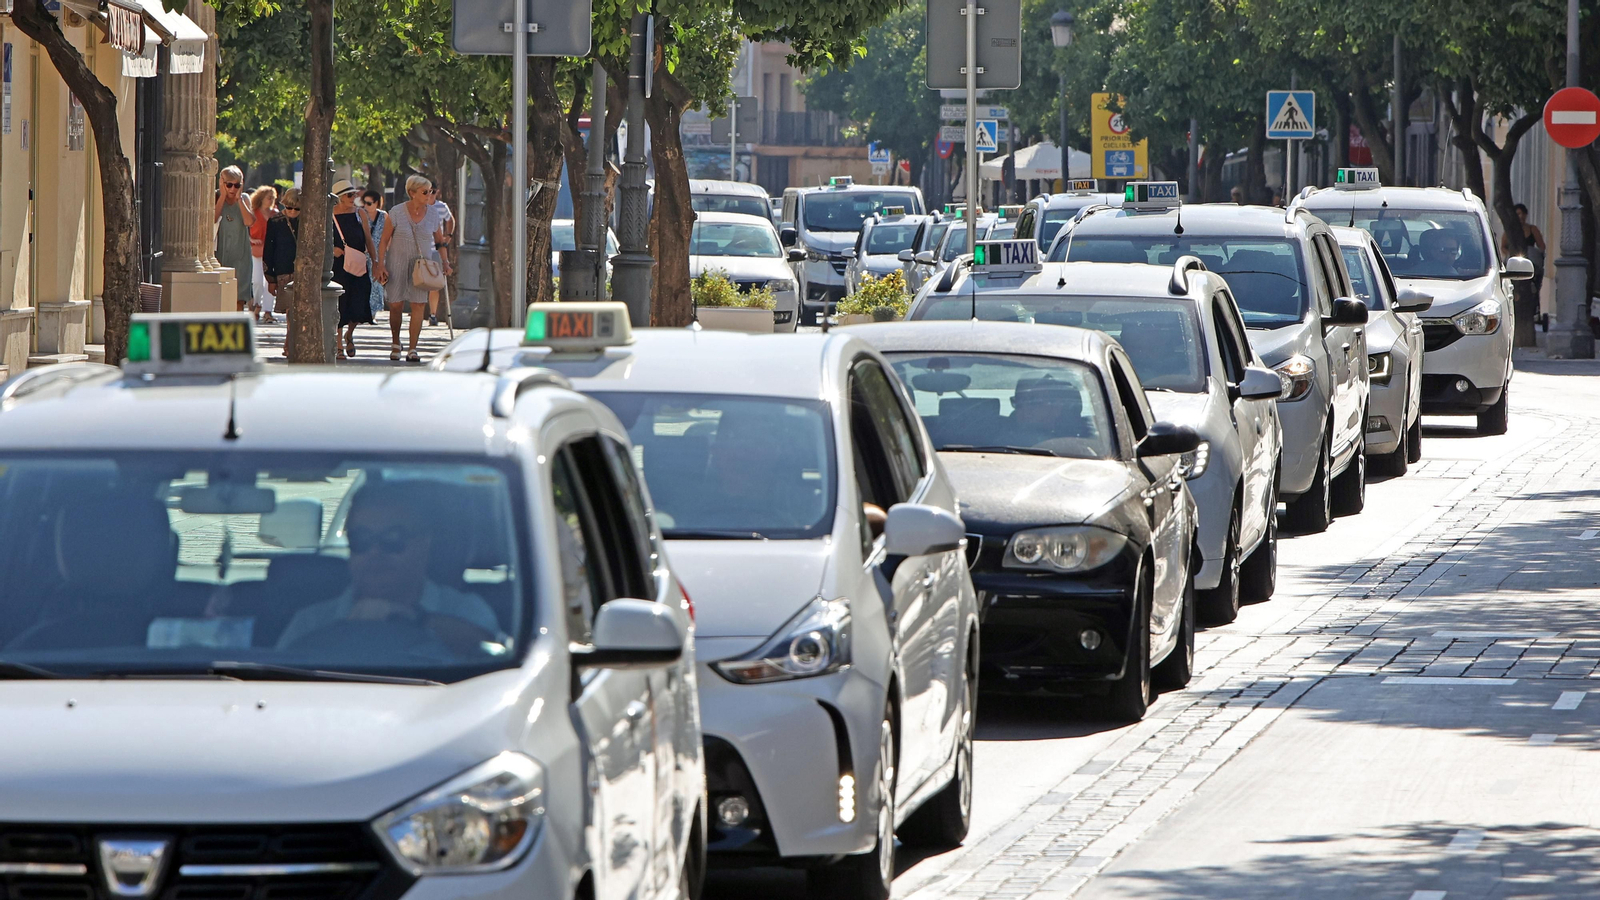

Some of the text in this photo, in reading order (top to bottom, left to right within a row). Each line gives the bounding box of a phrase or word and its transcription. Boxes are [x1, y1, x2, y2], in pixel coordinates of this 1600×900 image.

[1357, 171, 1376, 182] TAXI
[1073, 181, 1090, 190] TAXI
[1150, 185, 1176, 197] TAXI
[1004, 242, 1034, 264] TAXI
[549, 312, 594, 338] TAXI
[185, 323, 246, 352] TAXI
